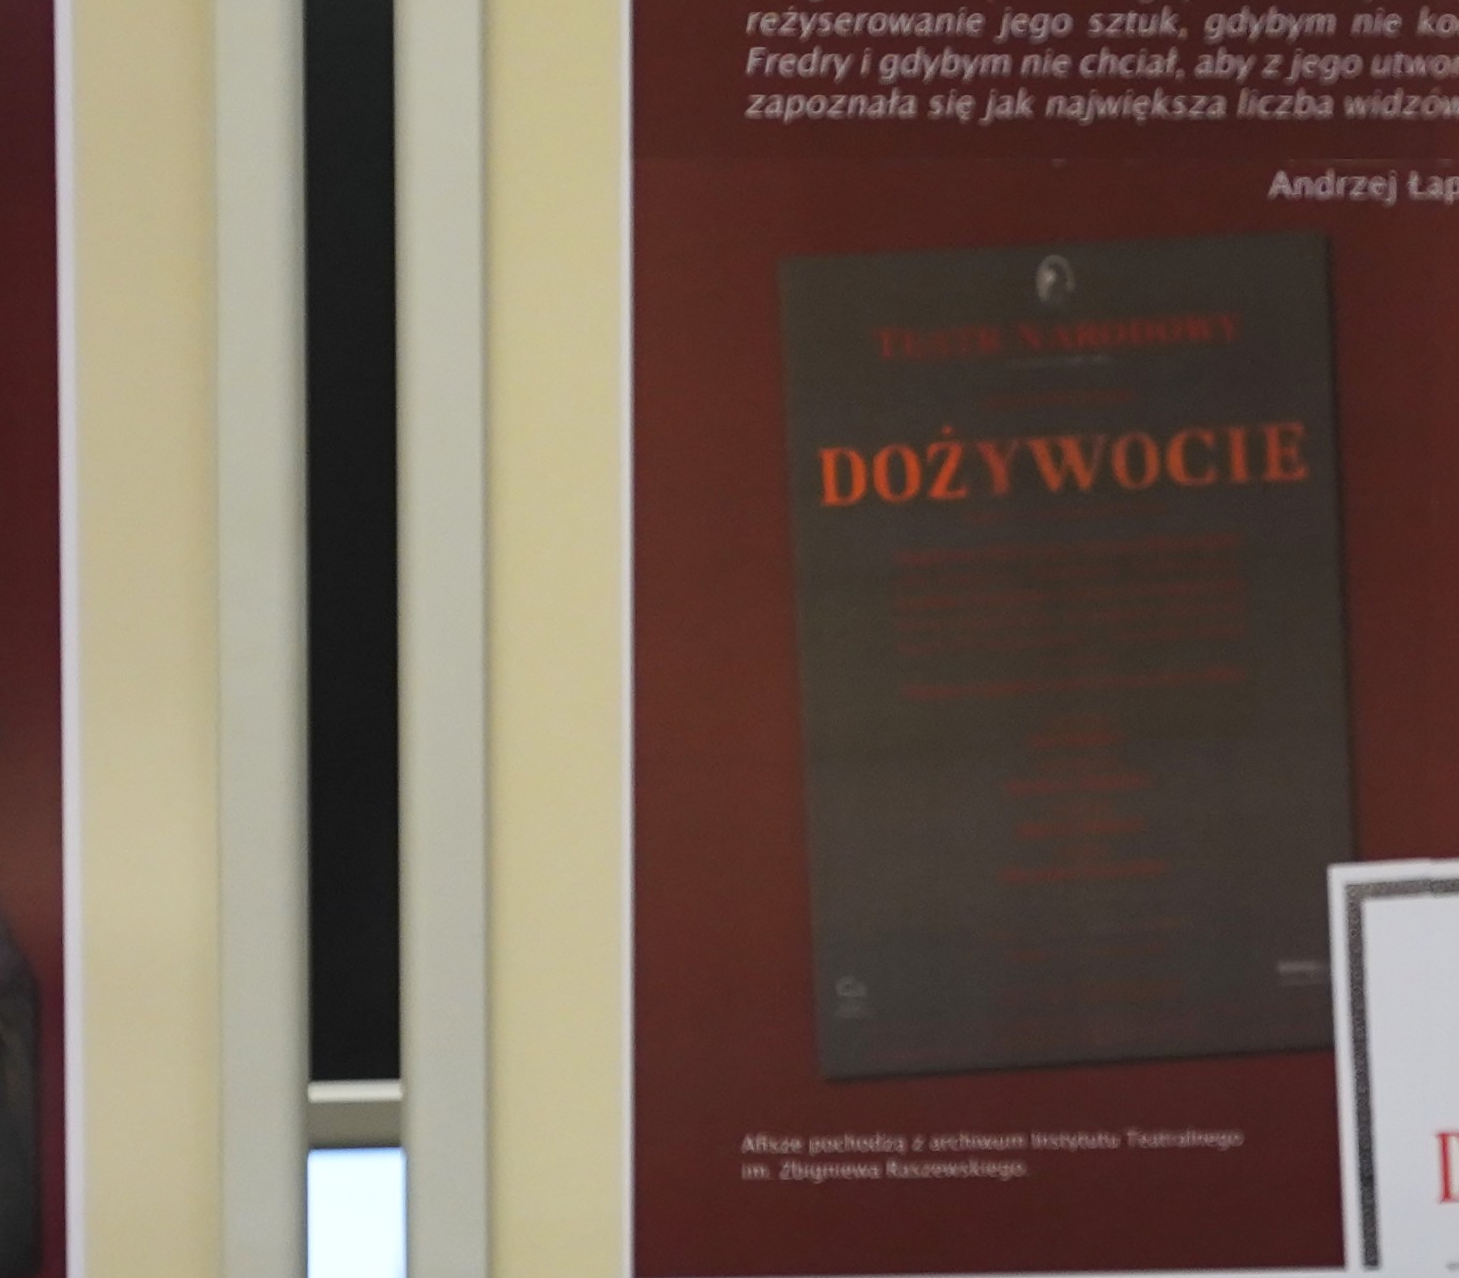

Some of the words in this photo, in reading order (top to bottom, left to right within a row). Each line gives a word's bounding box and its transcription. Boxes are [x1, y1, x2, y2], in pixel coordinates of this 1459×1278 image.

[746, 6, 984, 39] reżyserowanie
[996, 13, 1073, 42] jego
[1089, 6, 1186, 37] sztuk,
[1204, 7, 1336, 43] gdybym
[1351, 8, 1402, 36] nie
[746, 47, 851, 80] Fredry
[860, 48, 871, 75] i
[879, 47, 1011, 83] gdybym
[1021, 54, 1071, 77] nie
[1079, 47, 1184, 78] chciał,
[1194, 47, 1255, 81] aby
[1262, 54, 1282, 77] z
[1286, 49, 1363, 83] jego
[745, 88, 916, 122] zapoznała
[929, 89, 975, 121] się
[979, 88, 1032, 124] jak
[1046, 88, 1226, 124] największa
[1237, 88, 1334, 119] liczba
[1268, 170, 1397, 205] Andrzej
[818, 422, 1310, 508] DOŻYWOCIE
